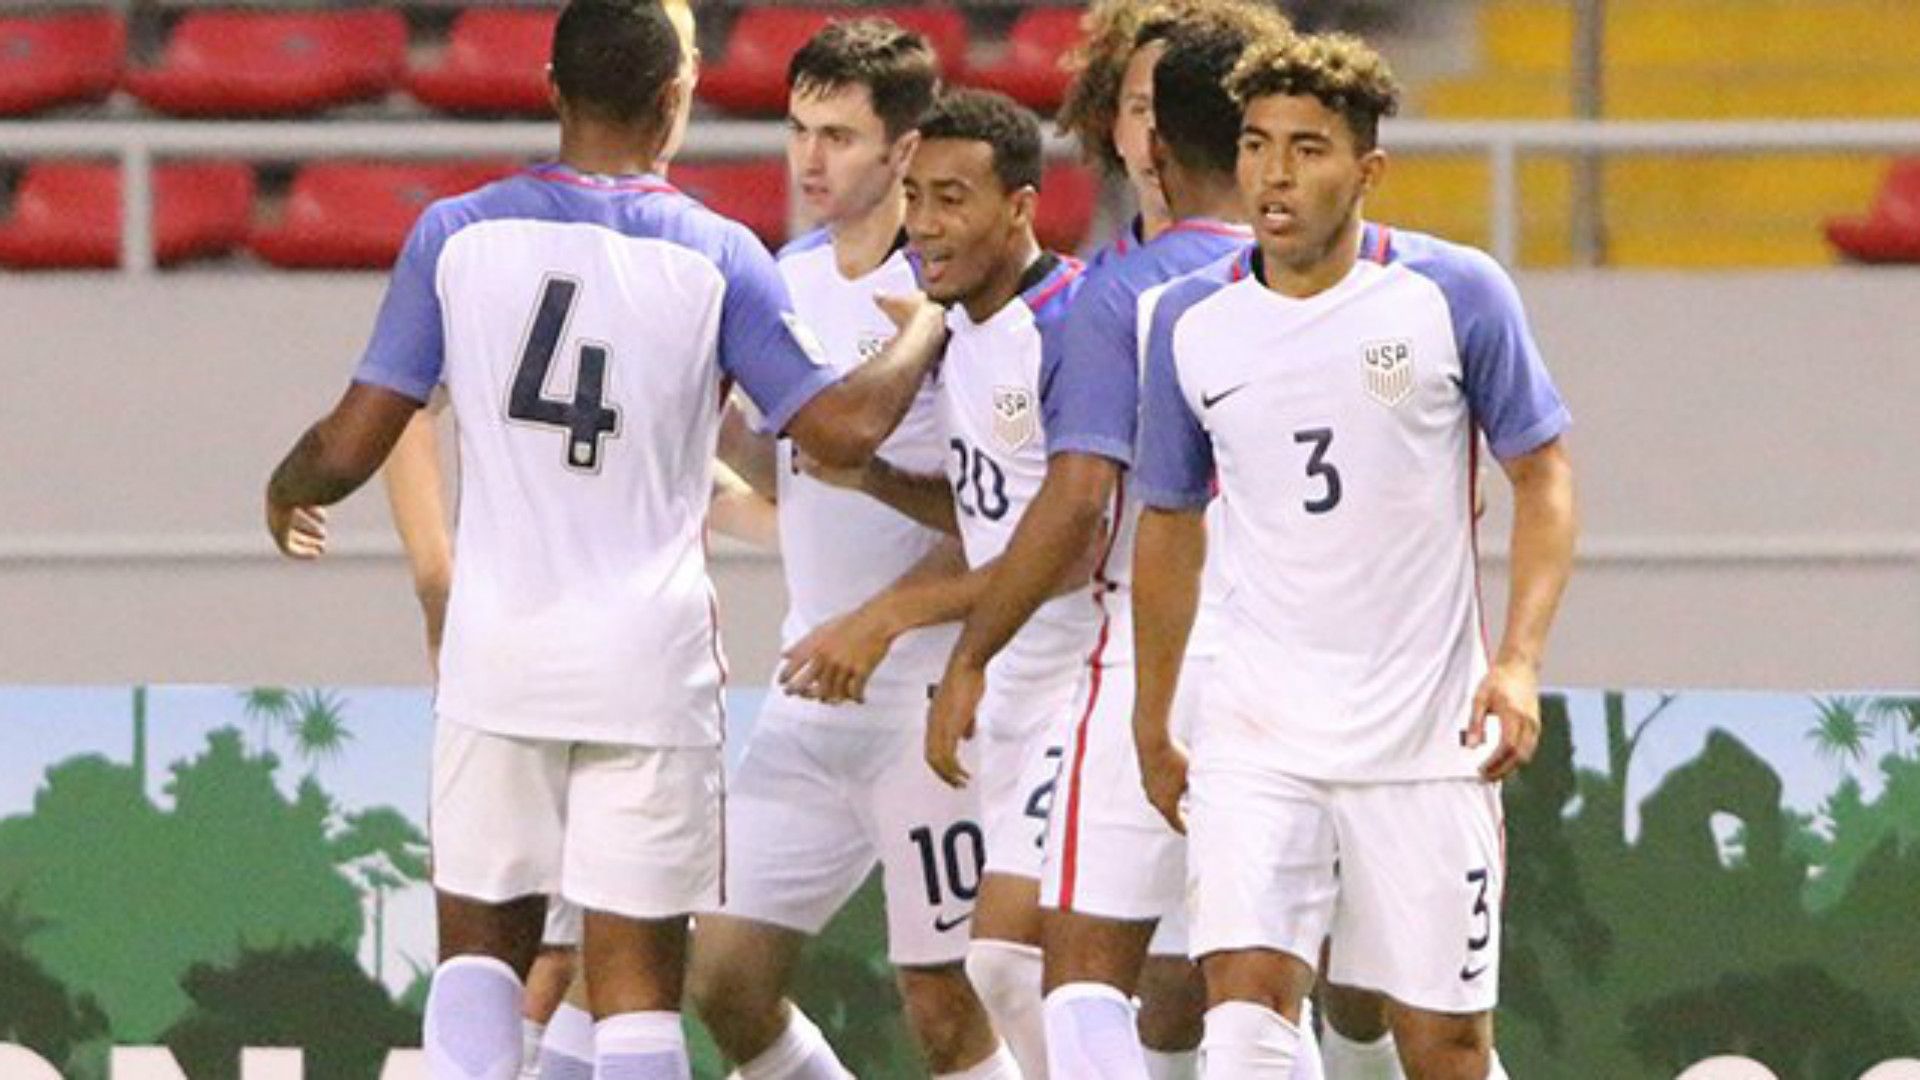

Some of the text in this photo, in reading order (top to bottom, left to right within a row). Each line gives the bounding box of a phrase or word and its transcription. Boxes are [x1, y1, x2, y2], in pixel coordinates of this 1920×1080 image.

[505, 273, 621, 473] 4
[1365, 343, 1408, 370] USA
[950, 437, 1009, 521] 20
[1293, 427, 1343, 514] 3
[908, 820, 987, 906] 10
[1465, 867, 1490, 951] 3
